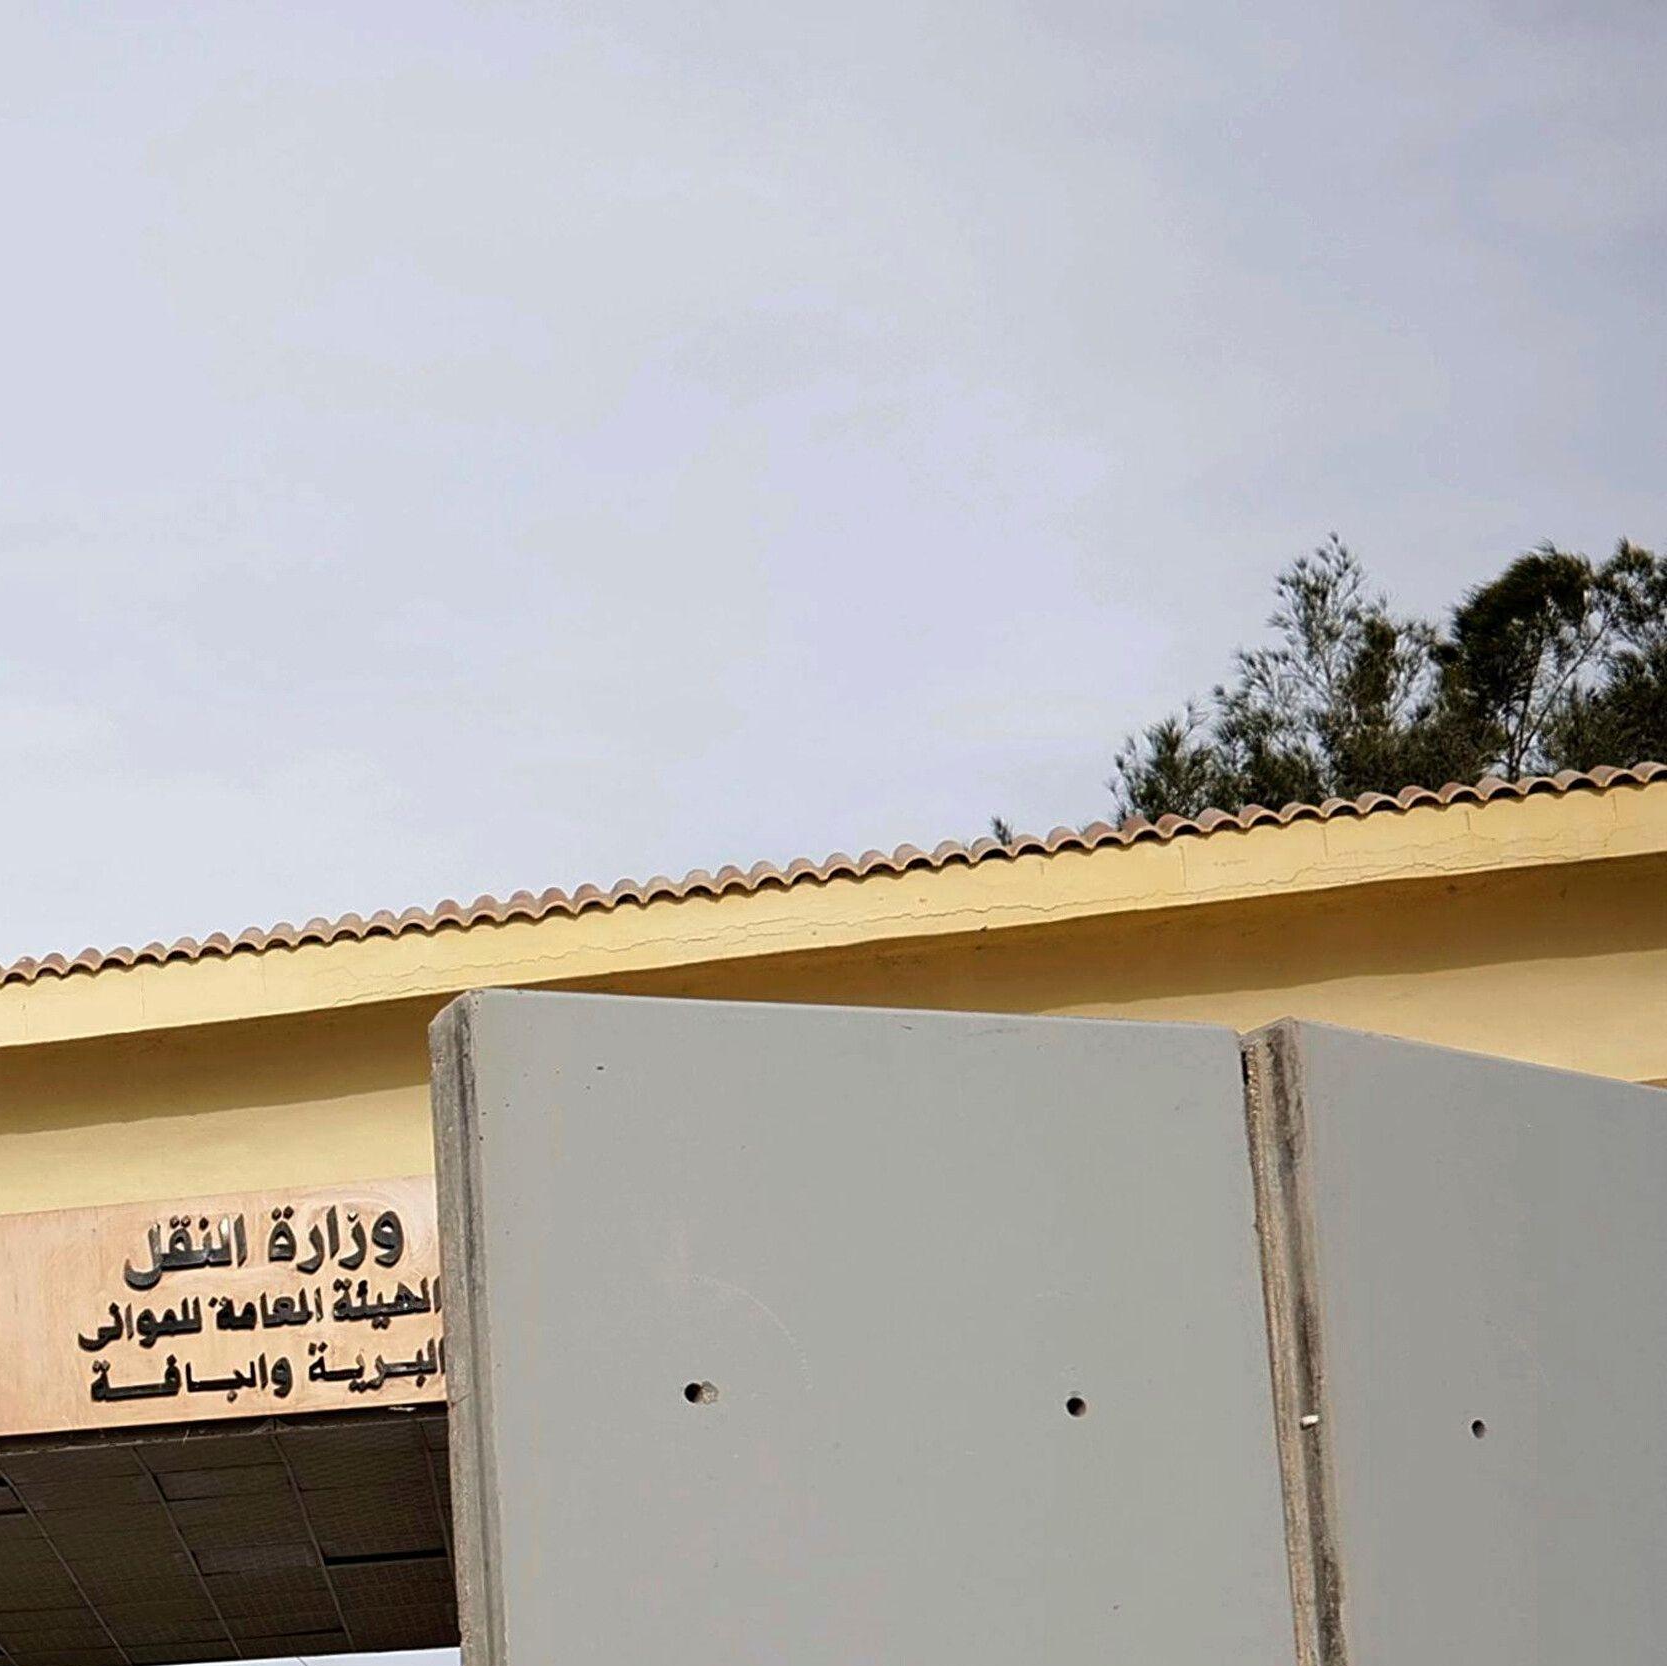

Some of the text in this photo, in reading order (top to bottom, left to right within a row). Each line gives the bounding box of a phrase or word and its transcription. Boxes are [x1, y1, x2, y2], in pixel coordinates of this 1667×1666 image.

[123, 1205, 405, 1290] وزارة النقل
[208, 1286, 322, 1332] العامة
[331, 1275, 443, 1331] الهيئة
[308, 1336, 446, 1393] البرية
